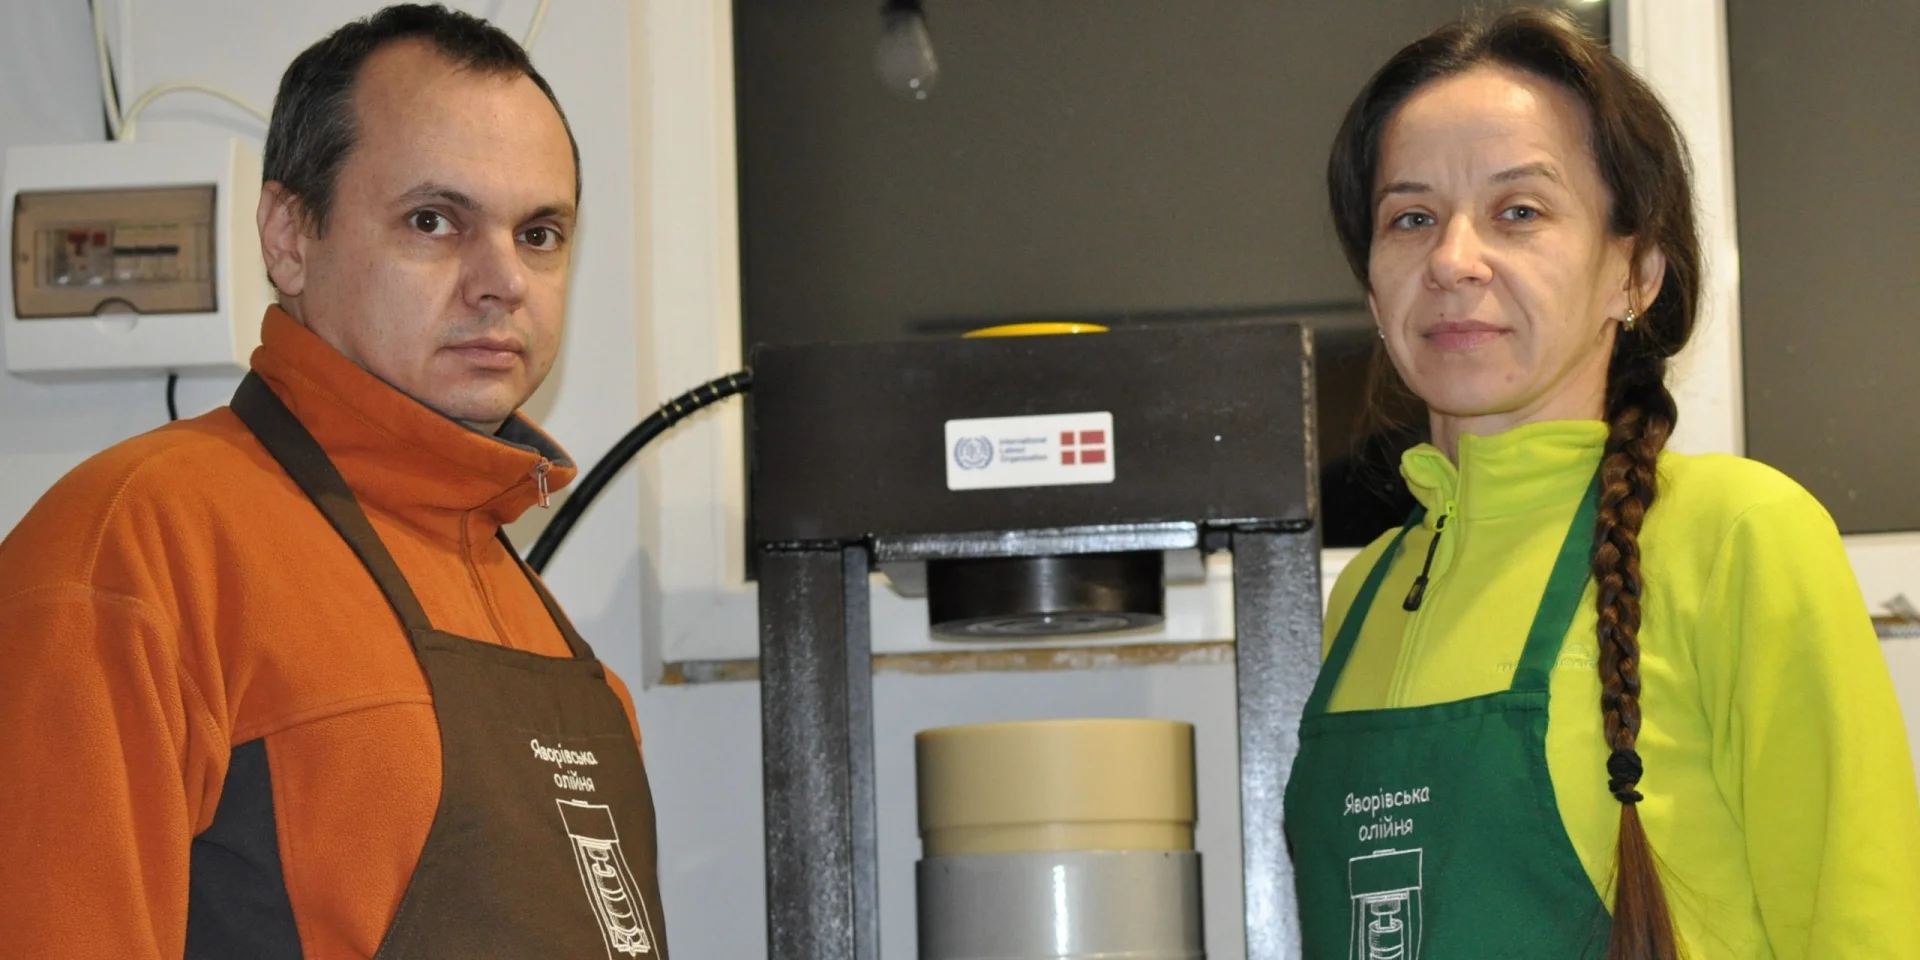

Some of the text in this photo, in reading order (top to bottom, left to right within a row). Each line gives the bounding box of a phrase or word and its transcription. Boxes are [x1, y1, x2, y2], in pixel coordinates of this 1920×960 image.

[999, 437, 1047, 445] International
[530, 739, 598, 769] Яворівська
[554, 770, 596, 792] олійня
[1343, 786, 1430, 818] Яворівська
[1358, 815, 1413, 842] олійня
